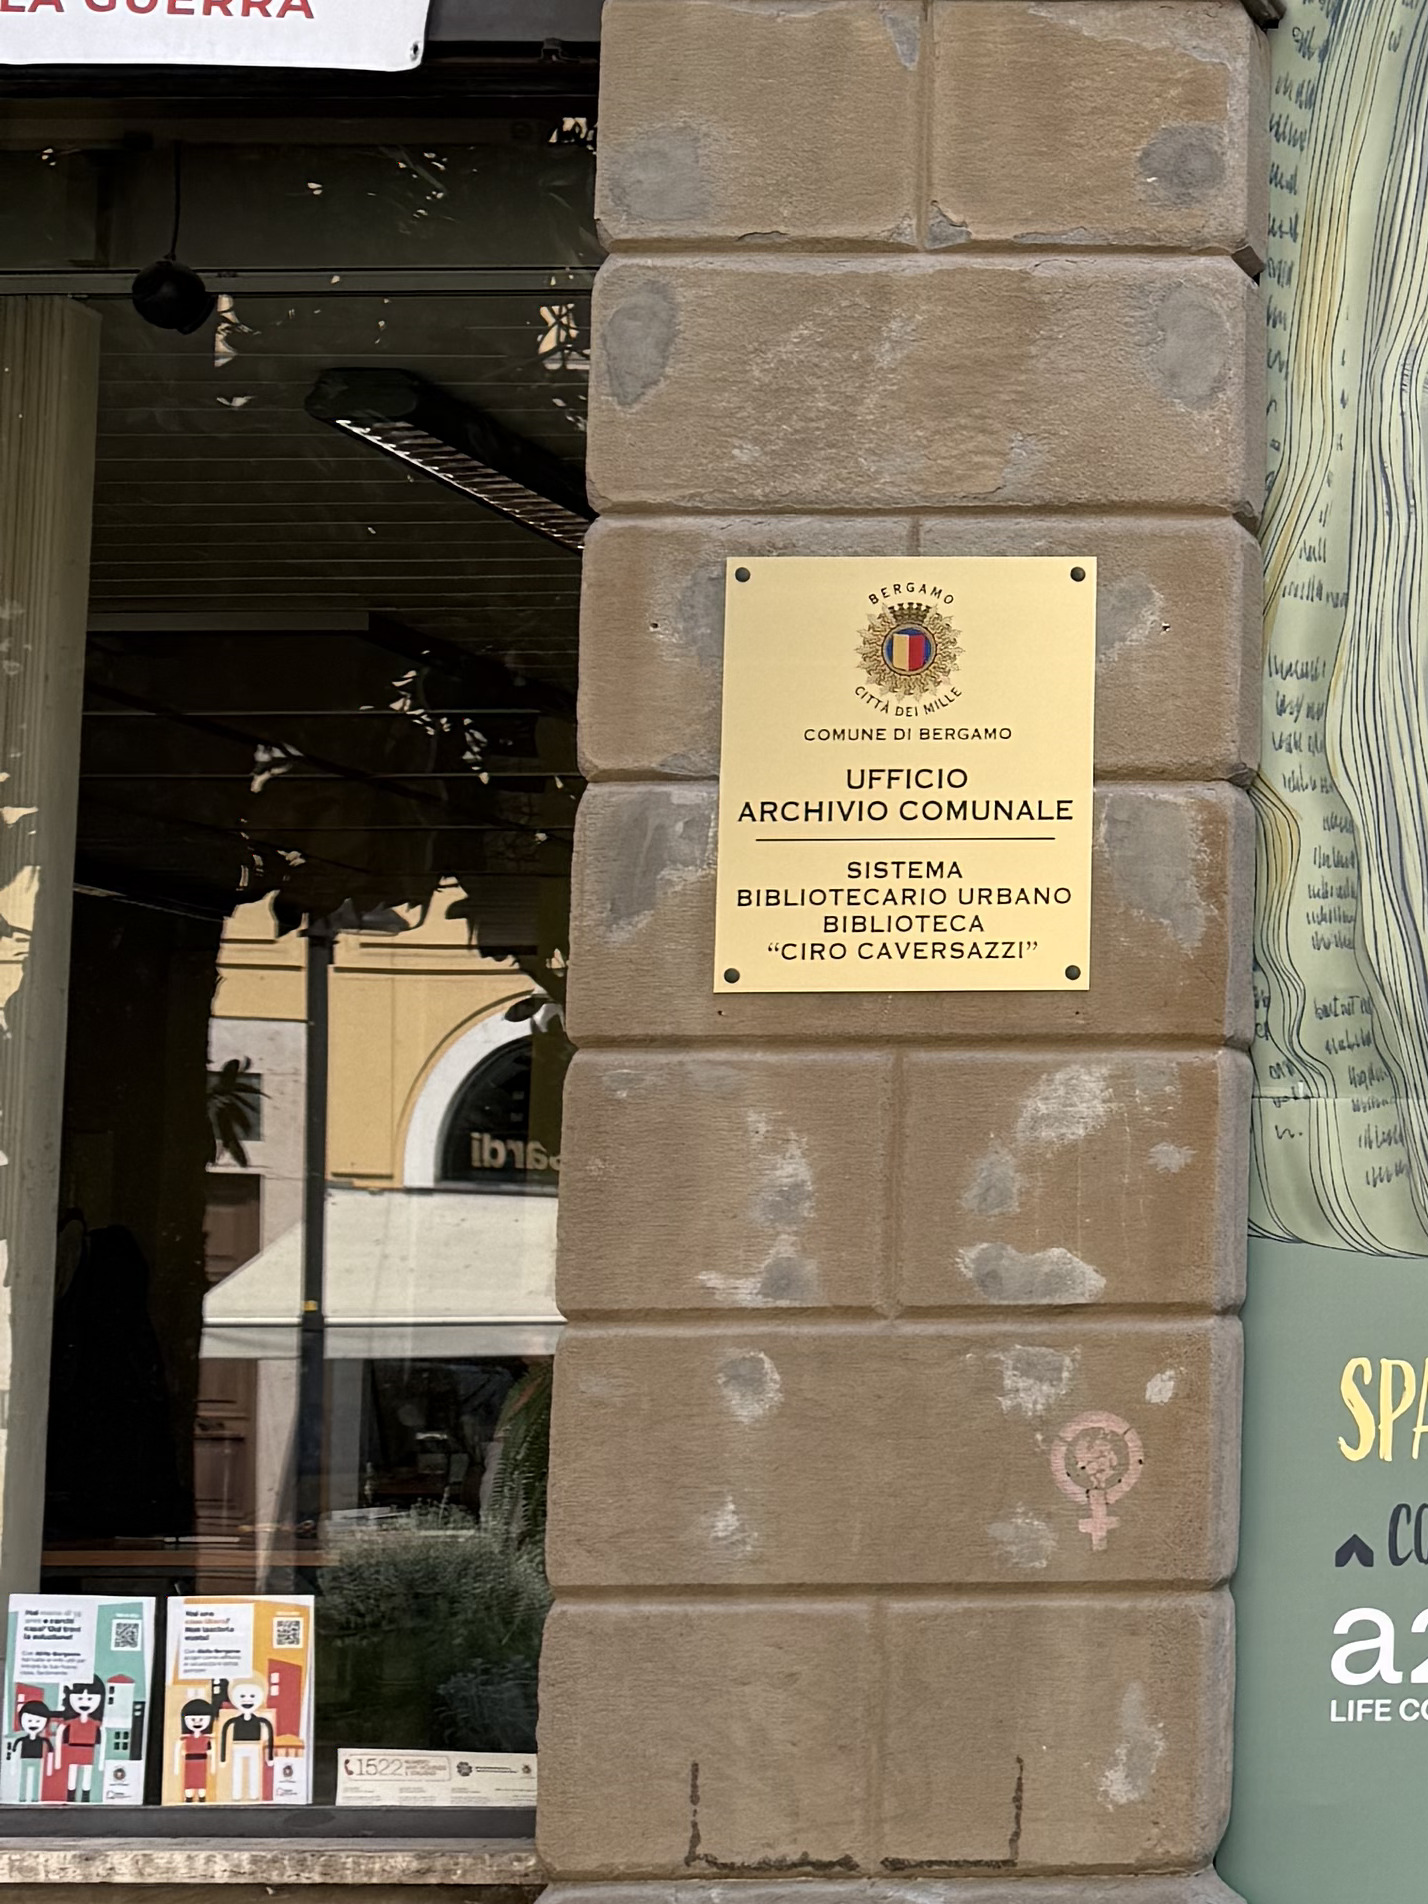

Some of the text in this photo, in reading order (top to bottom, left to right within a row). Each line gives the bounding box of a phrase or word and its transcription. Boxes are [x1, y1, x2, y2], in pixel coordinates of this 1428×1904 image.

[868, 581, 955, 606] BERGAMO
[854, 685, 962, 717] CITTÀ DEI MILLE
[804, 728, 1012, 741] COMUNE DI BERGAMO
[846, 769, 968, 789] UFFICIO
[738, 800, 1073, 822] ARCHIVIO COMUNALE
[847, 861, 962, 880] SISTEMA
[737, 888, 1071, 906] BIBLIOTECARIO URBANO
[823, 915, 984, 933] BIBLIOTECA
[1330, 1699, 1391, 1723] LIFE
[356, 1758, 402, 1776] 1522
